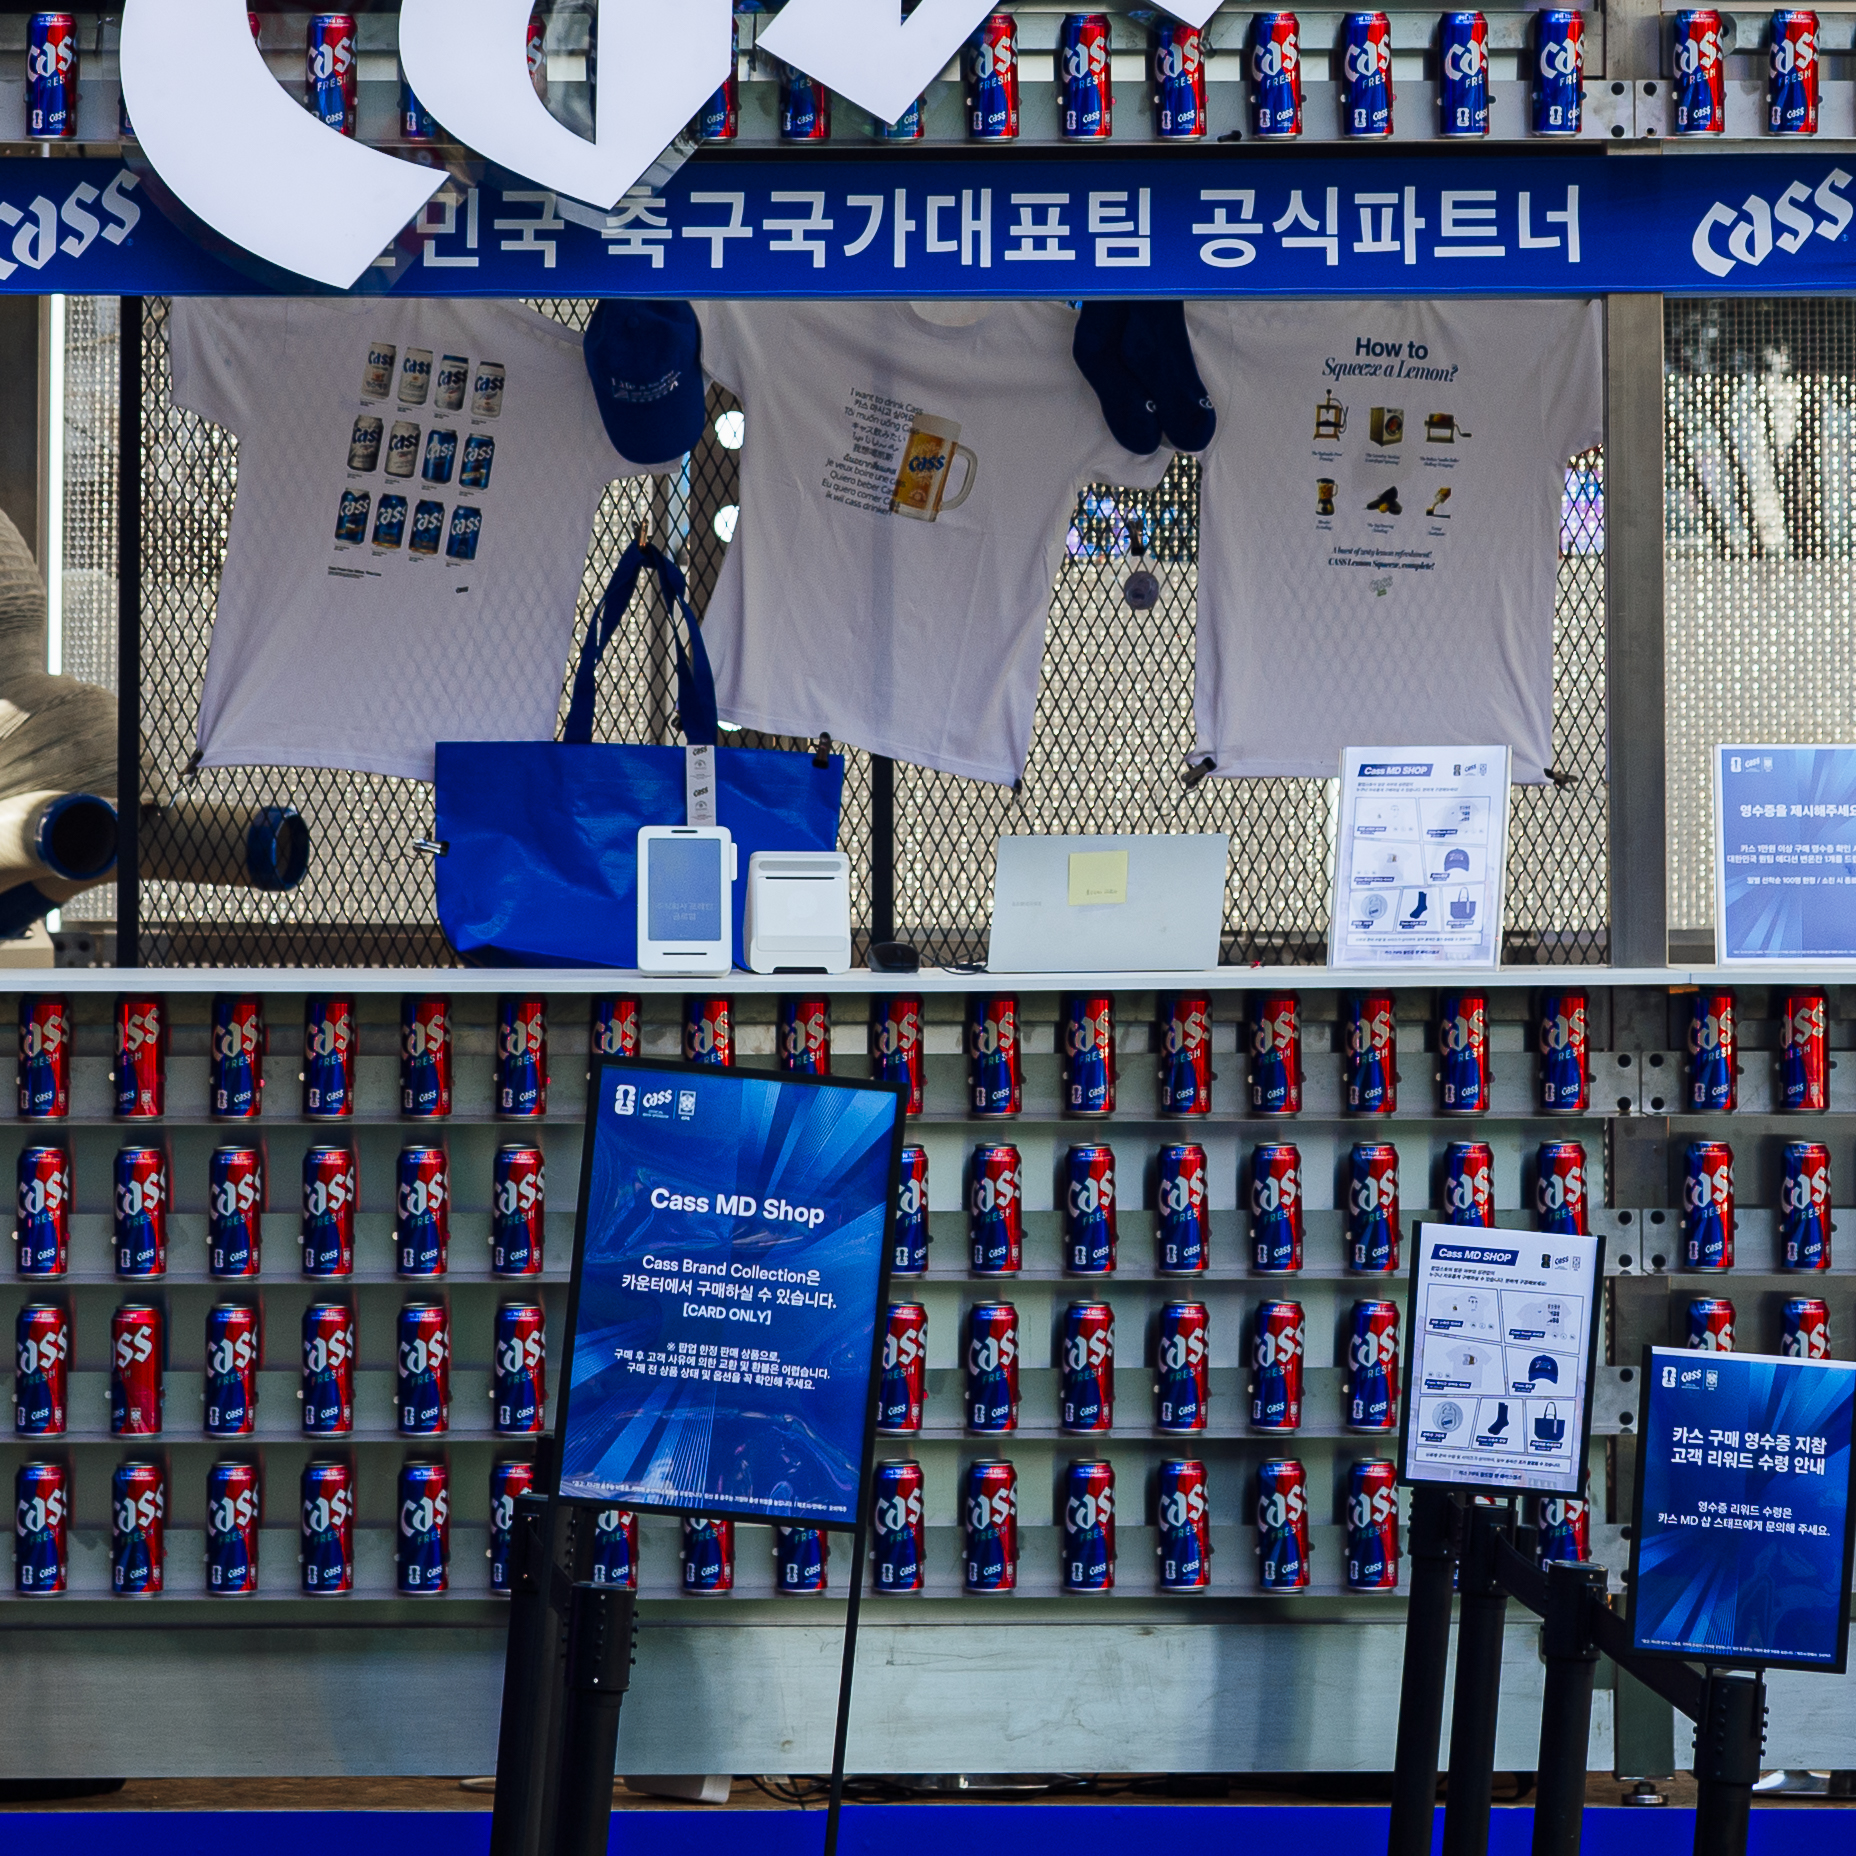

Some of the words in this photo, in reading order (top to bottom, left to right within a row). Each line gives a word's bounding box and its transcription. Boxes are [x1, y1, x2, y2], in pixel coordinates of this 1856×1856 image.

[603, 187, 1154, 269] 축구국가대표팀
[1192, 185, 1583, 266] 공식파트너
[1355, 337, 1402, 359] How
[1407, 341, 1428, 360] to
[1322, 357, 1382, 382] Squeeze
[1384, 365, 1393, 377] a
[1396, 359, 1459, 382] Lemon?
[875, 396, 883, 404] to
[884, 397, 903, 409] drink
[1364, 766, 1385, 775] Cass
[1386, 766, 1401, 775] MD
[1403, 766, 1428, 775] SHOP
[1740, 804, 1787, 818] 영수증을
[650, 1187, 710, 1214] Cass
[716, 1192, 757, 1217] MD
[762, 1196, 825, 1229] Shop
[1439, 1248, 1463, 1259] Cass
[1464, 1250, 1482, 1261] MD
[1483, 1251, 1511, 1263] SHOP
[642, 1255, 678, 1272] Cass
[682, 1258, 726, 1276] Brand
[730, 1261, 821, 1286] Collection은
[621, 1273, 692, 1296] 카운터에서
[697, 1280, 753, 1302] 구매하실
[757, 1285, 773, 1304] 수
[776, 1287, 837, 1310] 있습니다.
[683, 1304, 726, 1323] [CARD
[728, 1306, 771, 1326] ONLY]
[1673, 1426, 1704, 1445] 카스
[1708, 1430, 1739, 1448] 구매
[1744, 1432, 1791, 1452] 영수증
[1796, 1436, 1826, 1455] 지참
[1671, 1448, 1702, 1466] 고객
[1708, 1450, 1753, 1469] 리워드
[1758, 1454, 1789, 1472] 수령
[1794, 1456, 1825, 1476] 안내
[1698, 1501, 1727, 1514] 영수증
[1731, 1503, 1760, 1516] 리워드
[1763, 1505, 1792, 1520] 수령은
[1658, 1513, 1677, 1526] 카스
[1681, 1515, 1698, 1527] MD
[1798, 1522, 1830, 1537] 주세요.
